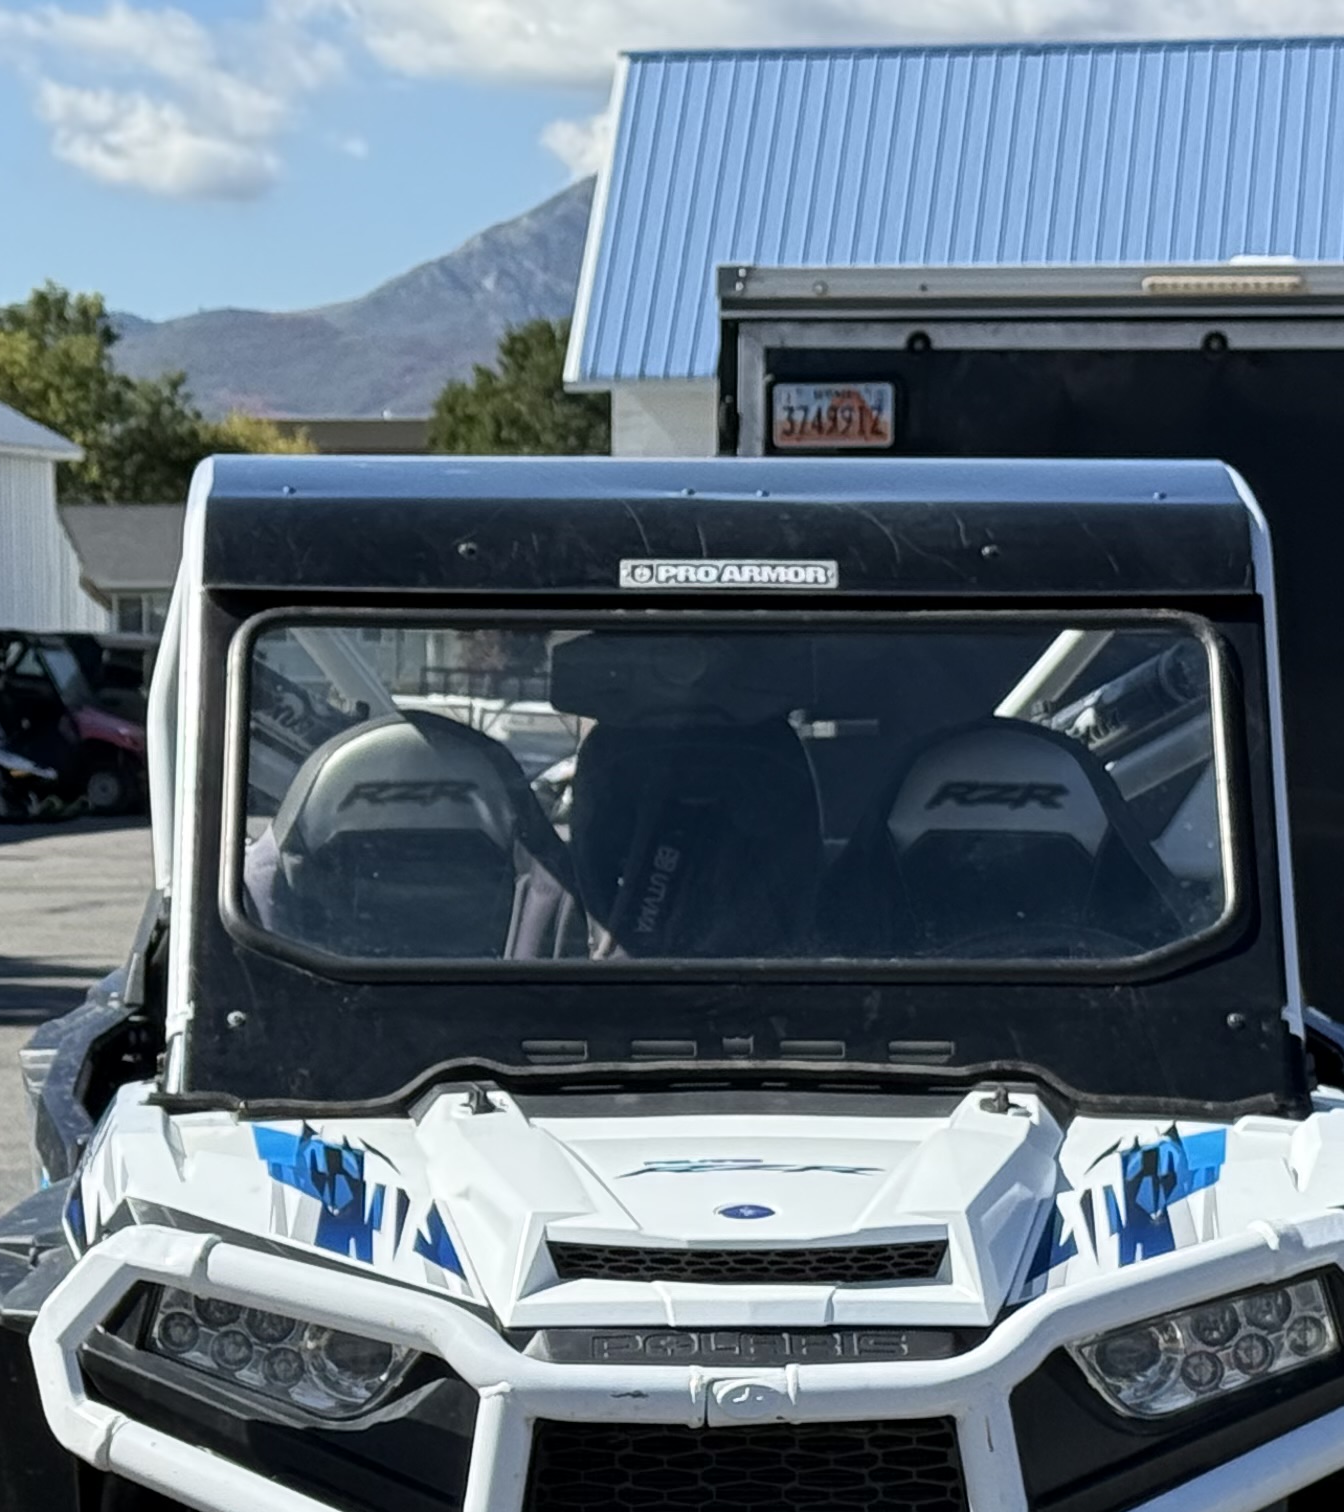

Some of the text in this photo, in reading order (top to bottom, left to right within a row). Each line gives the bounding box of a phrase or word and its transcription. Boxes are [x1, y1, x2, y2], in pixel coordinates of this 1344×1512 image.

[336, 779, 479, 813] RZR
[924, 780, 1071, 811] RZR
[592, 1331, 910, 1359] POLARIS
